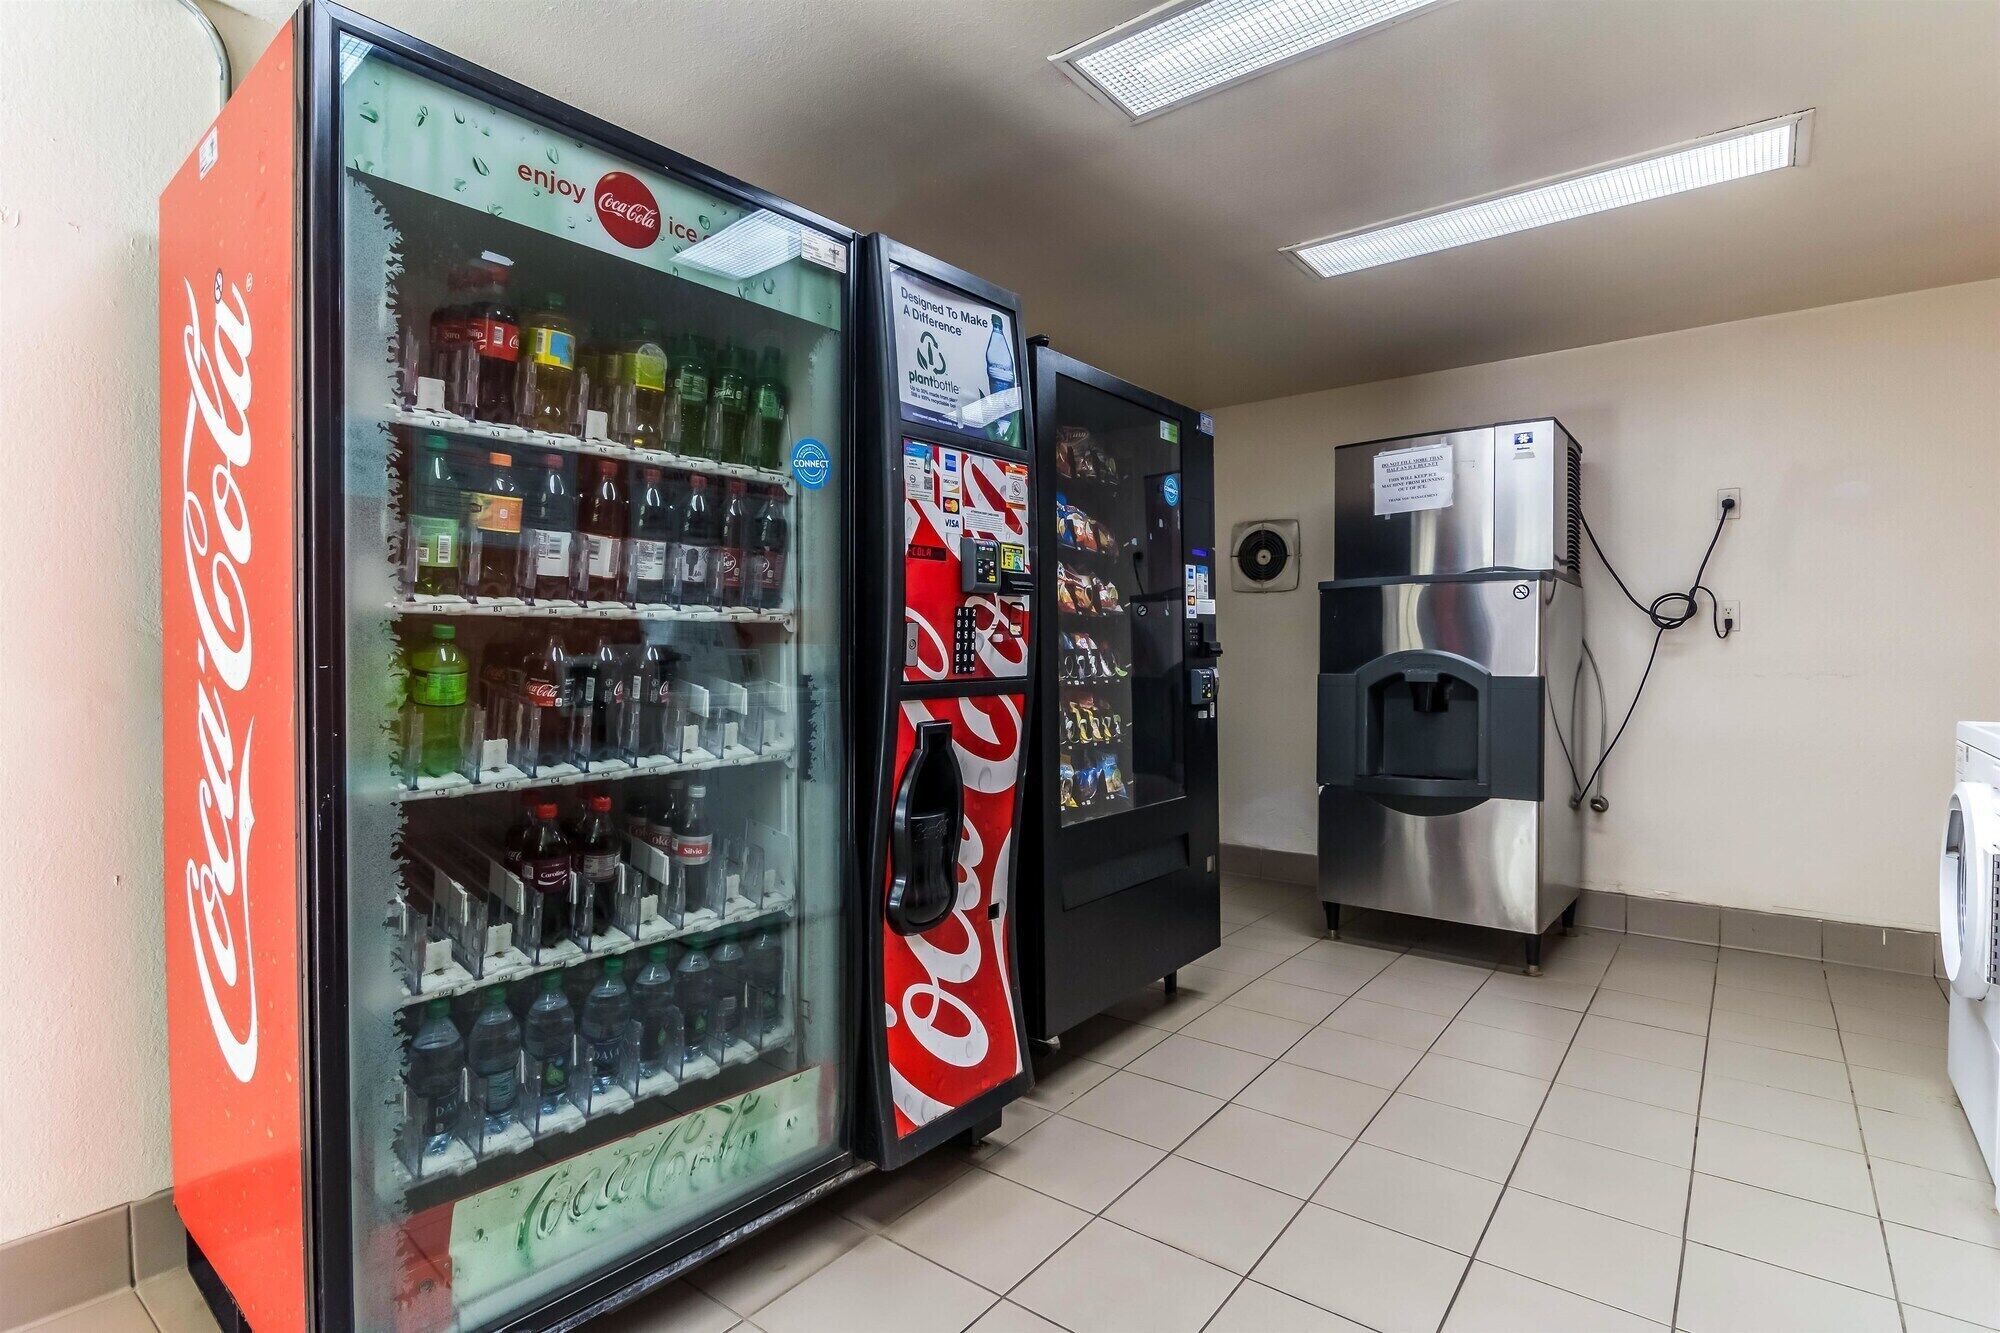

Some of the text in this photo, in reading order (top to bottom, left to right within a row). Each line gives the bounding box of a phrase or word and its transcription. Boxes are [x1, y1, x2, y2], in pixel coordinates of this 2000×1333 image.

[517, 161, 698, 243] enjoy Coca-Cola ice
[900, 286, 988, 329] Designed To Make
[903, 304, 962, 336] A Difference
[908, 369, 960, 395] plantbottle
[793, 459, 829, 468] CONNECT
[944, 518, 960, 528] VISA
[957, 608, 977, 617] A 1 2
[964, 619, 969, 628] 3
[971, 619, 976, 628] 4
[956, 630, 961, 639] C
[964, 630, 968, 639] 5
[955, 642, 961, 651] D
[963, 642, 968, 651] 7
[955, 653, 975, 662] E 9 0
[955, 665, 960, 674] F
[184, 276, 258, 1083] Coca-Cola
[684, 847, 703, 855] Silvia
[514, 1093, 759, 1251] Coca-Cola
